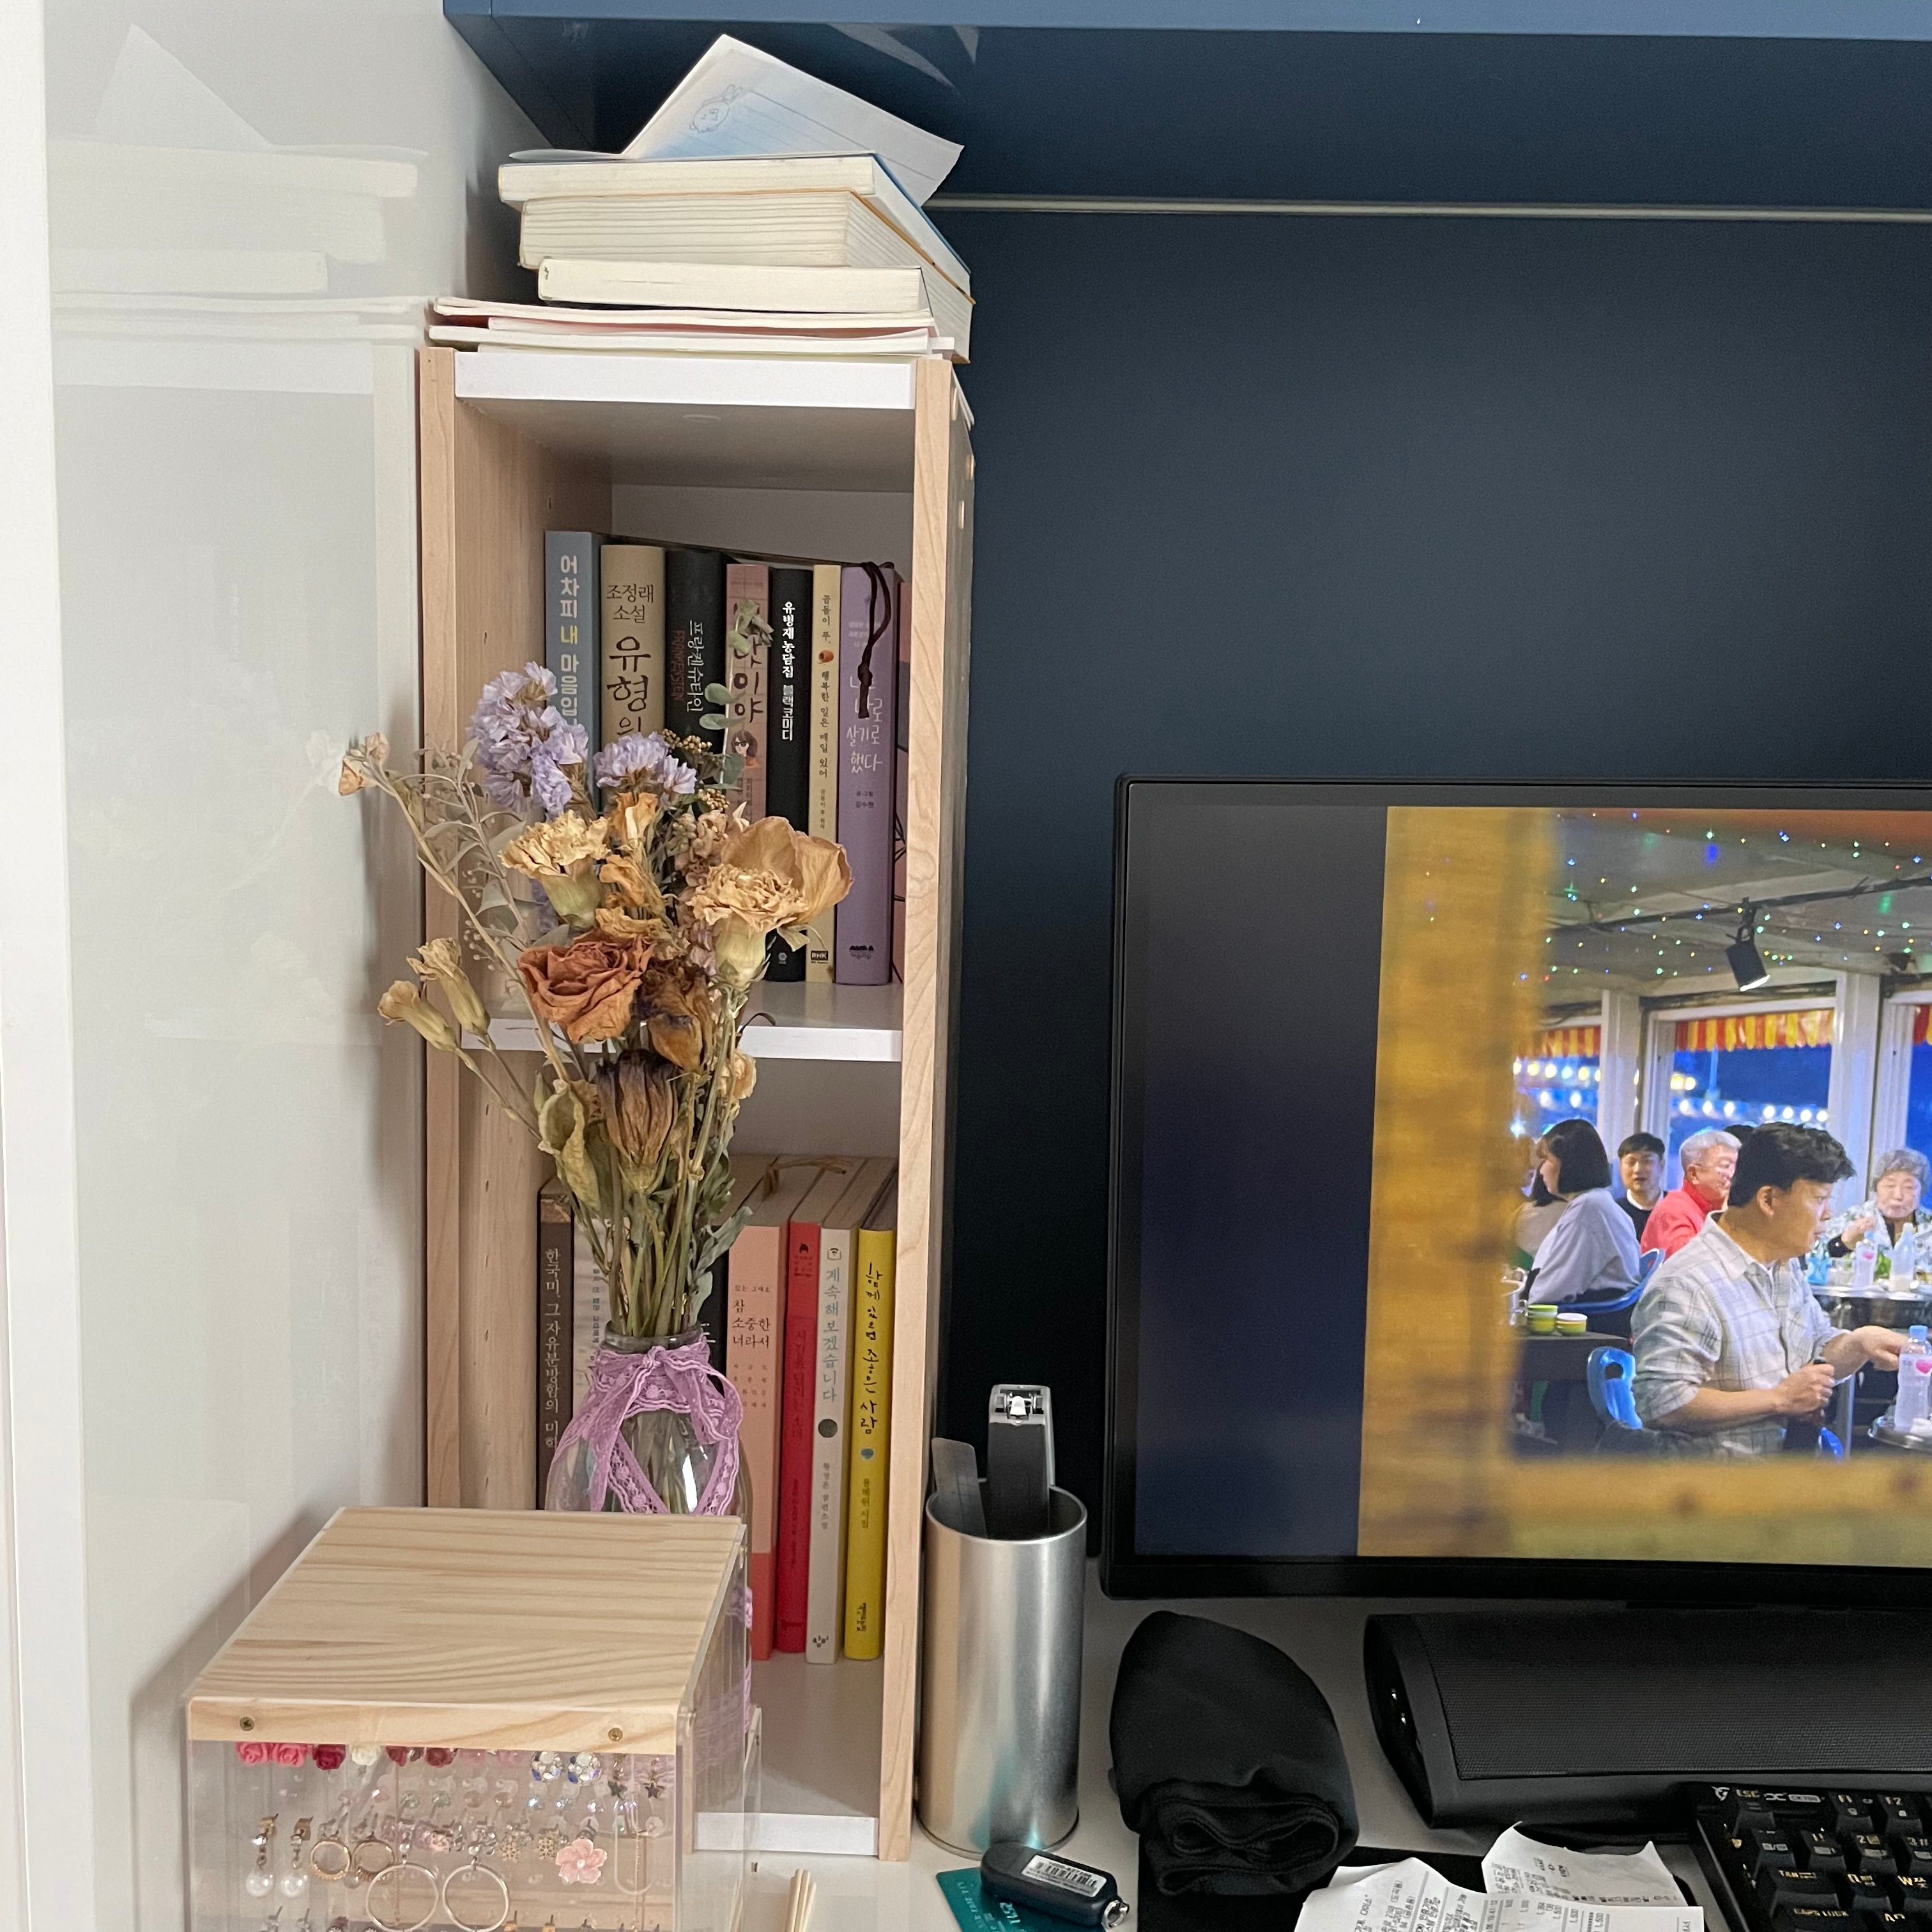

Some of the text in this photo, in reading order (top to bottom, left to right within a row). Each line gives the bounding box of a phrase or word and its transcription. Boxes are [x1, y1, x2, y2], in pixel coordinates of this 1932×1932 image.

[606, 583, 654, 604] 조정래
[613, 605, 646, 624] 소설
[822, 595, 831, 626] 곰돌이
[560, 555, 579, 726] 어차피 내 마음입
[687, 620, 704, 712] 프랑켄슈타인
[606, 636, 651, 735] 유형의
[782, 684, 794, 741] 블랙코미디
[819, 670, 830, 779] 행복한 일은 매일 있어
[846, 724, 880, 747] 살기로
[850, 751, 884, 774] 했다
[544, 1303, 561, 1316] 그
[733, 1298, 746, 1314] 참
[732, 1317, 771, 1332] 소중한
[822, 1267, 841, 1402] 계속해보겠습니다
[732, 1334, 770, 1349] 너라서
[860, 1262, 884, 1434] 함께 있으면 좋은 사람
